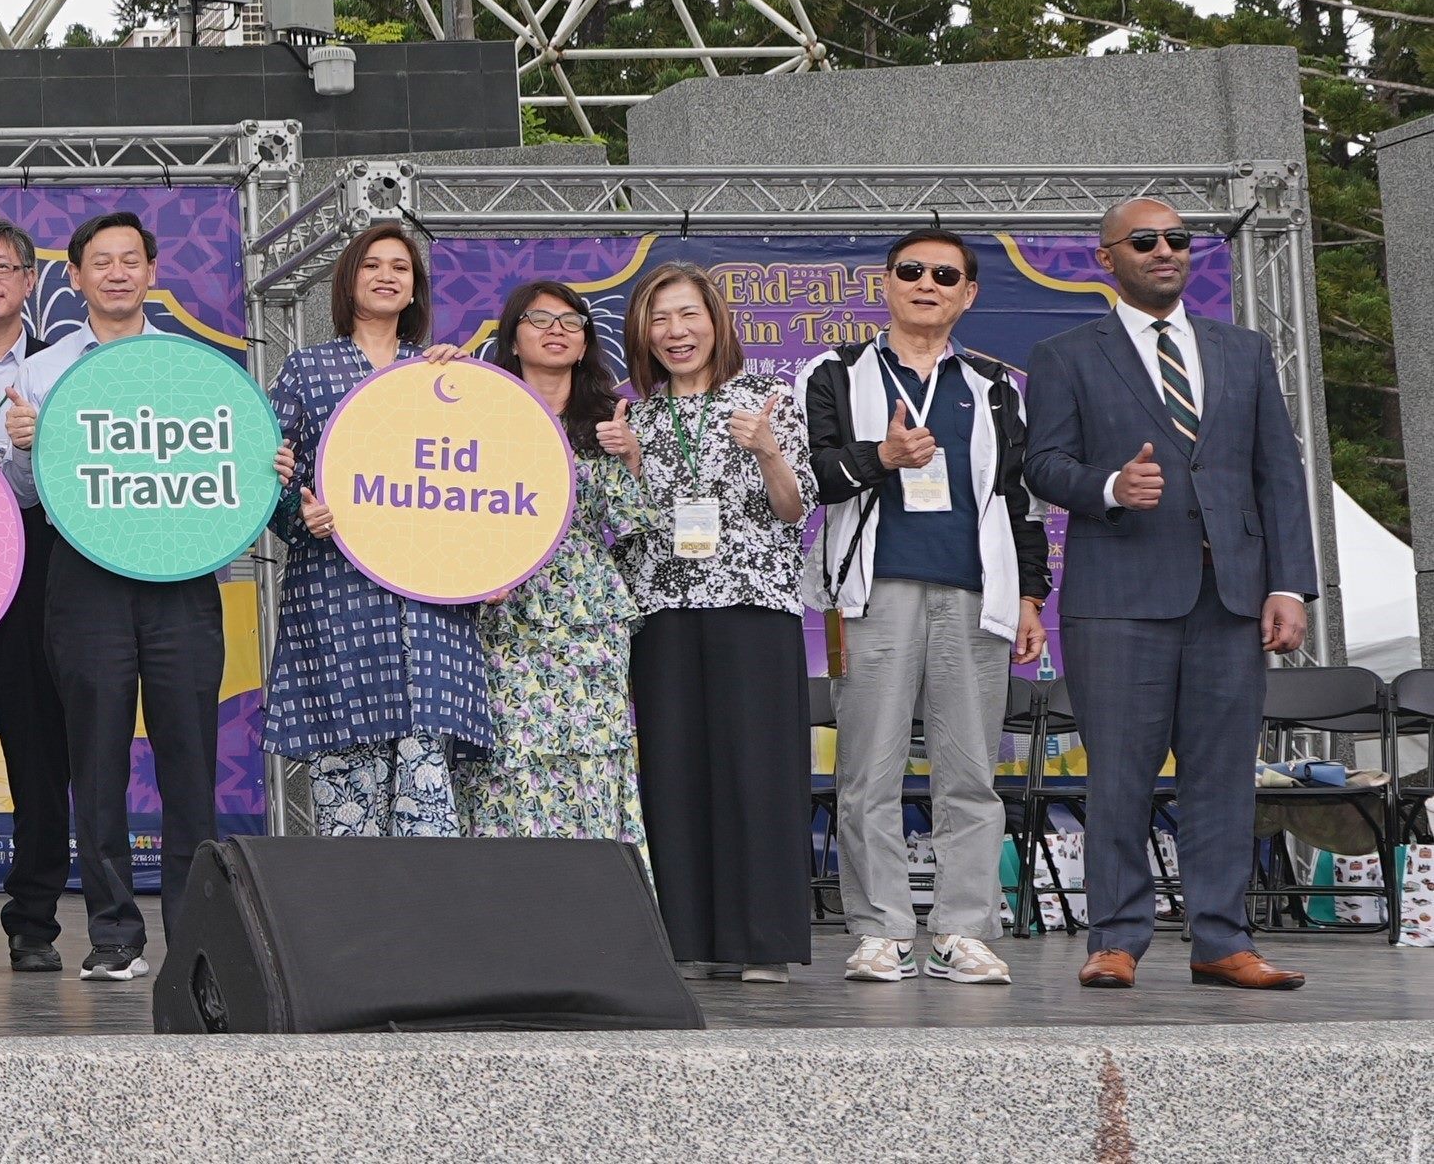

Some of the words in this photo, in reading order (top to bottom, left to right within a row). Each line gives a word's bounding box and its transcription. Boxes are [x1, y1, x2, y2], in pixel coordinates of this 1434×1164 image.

[714, 269, 886, 305] Eid-al-F
[792, 269, 823, 278] 2025
[742, 312, 782, 344] in
[789, 307, 890, 344] Taip
[80, 409, 229, 460] Taipei
[414, 436, 478, 473] Eid
[80, 465, 236, 505] Travel
[353, 473, 539, 517] Mubarak
